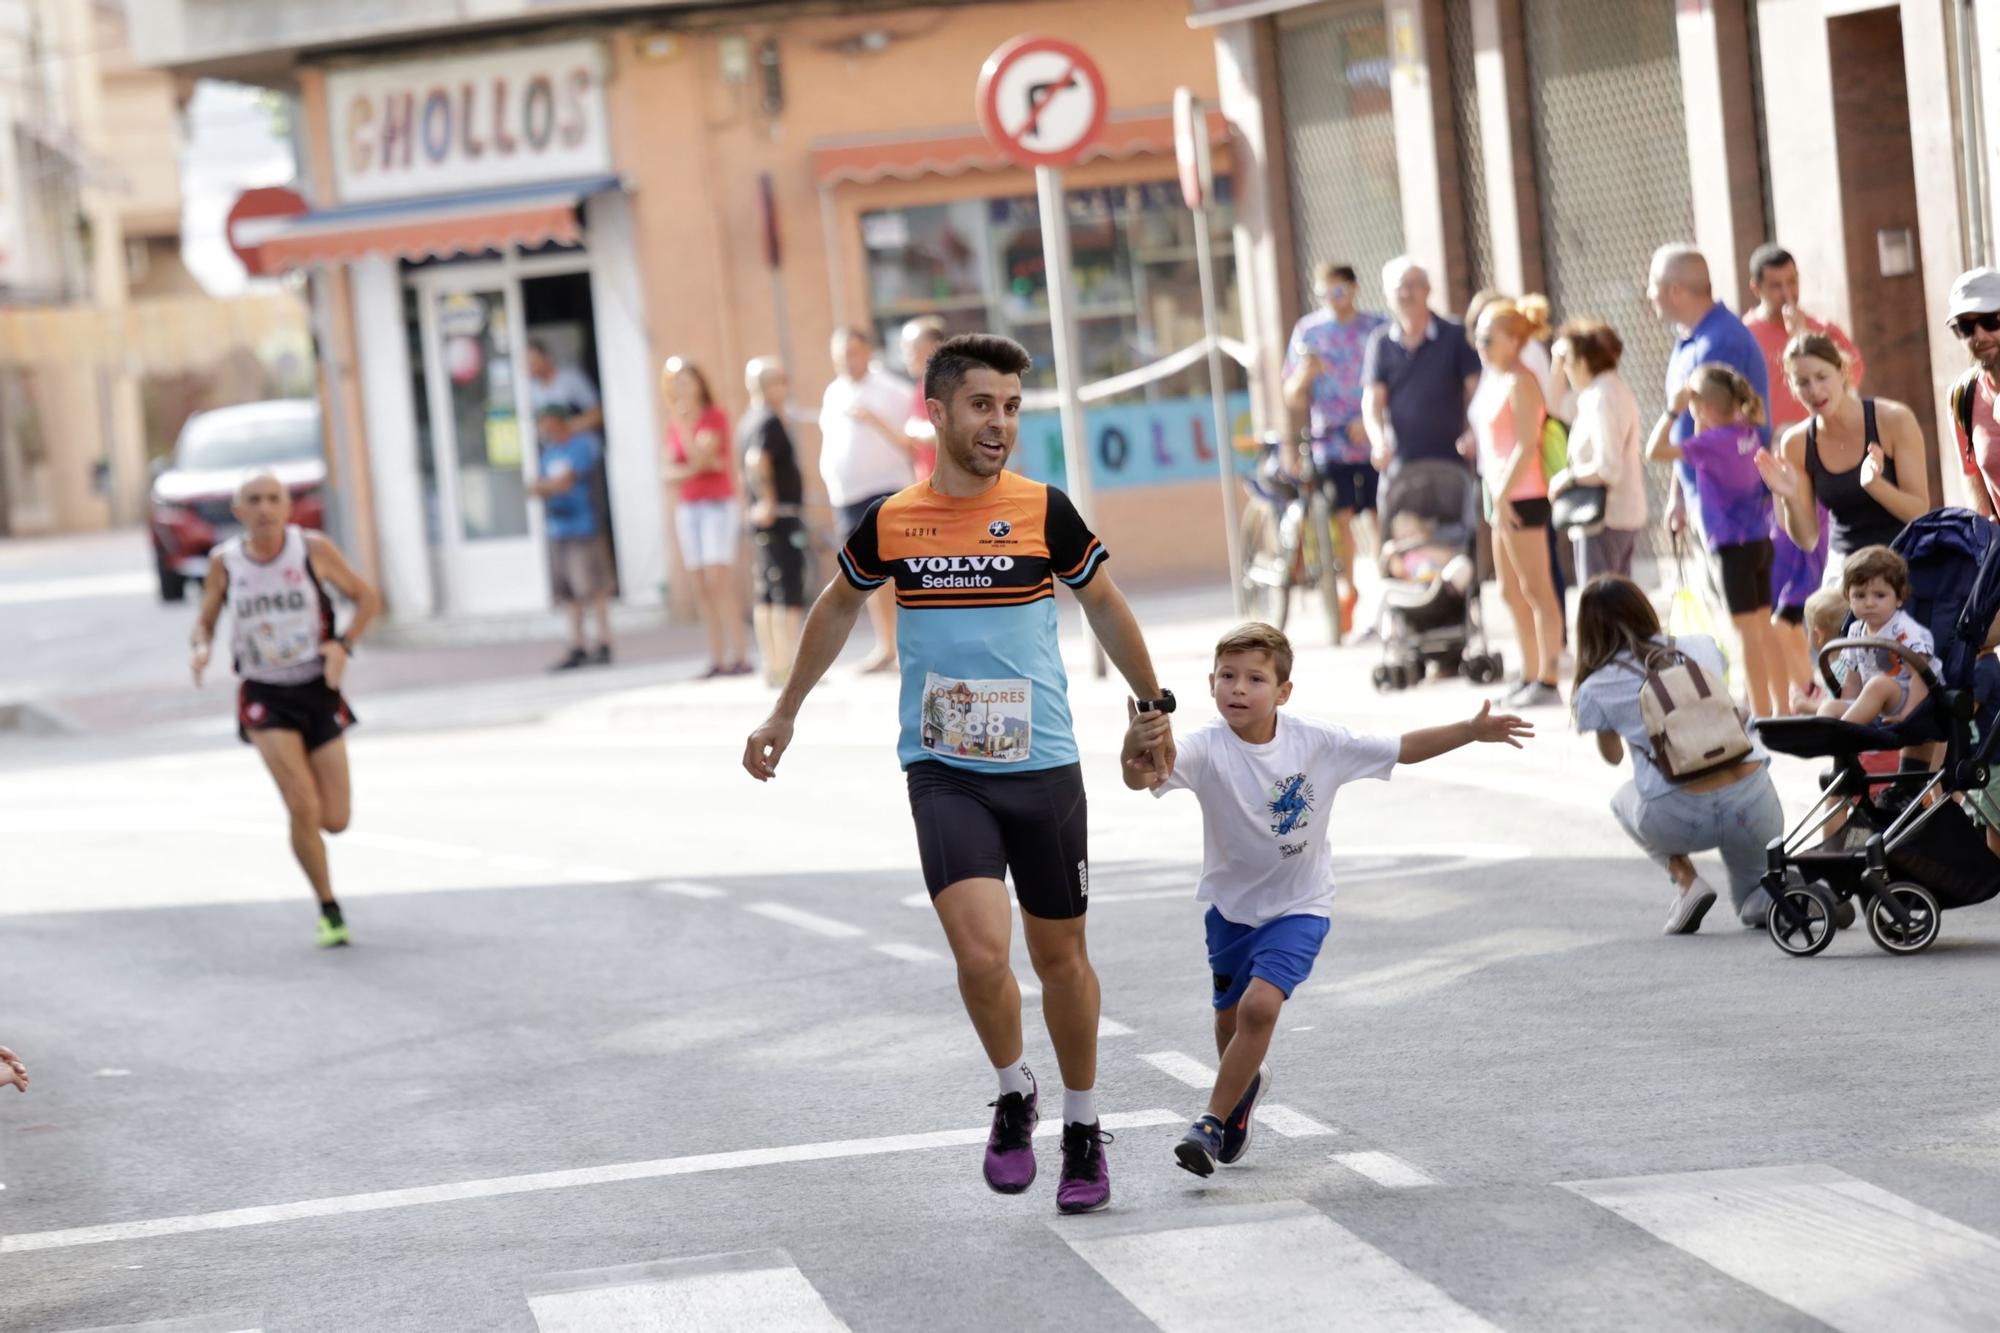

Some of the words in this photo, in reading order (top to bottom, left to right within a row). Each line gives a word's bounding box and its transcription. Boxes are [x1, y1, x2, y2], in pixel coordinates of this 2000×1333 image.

[346, 66, 590, 174] CHOLLOS
[903, 555, 1015, 573] VOLVO
[921, 574, 993, 589] Sedauto
[944, 709, 1006, 737] 288
